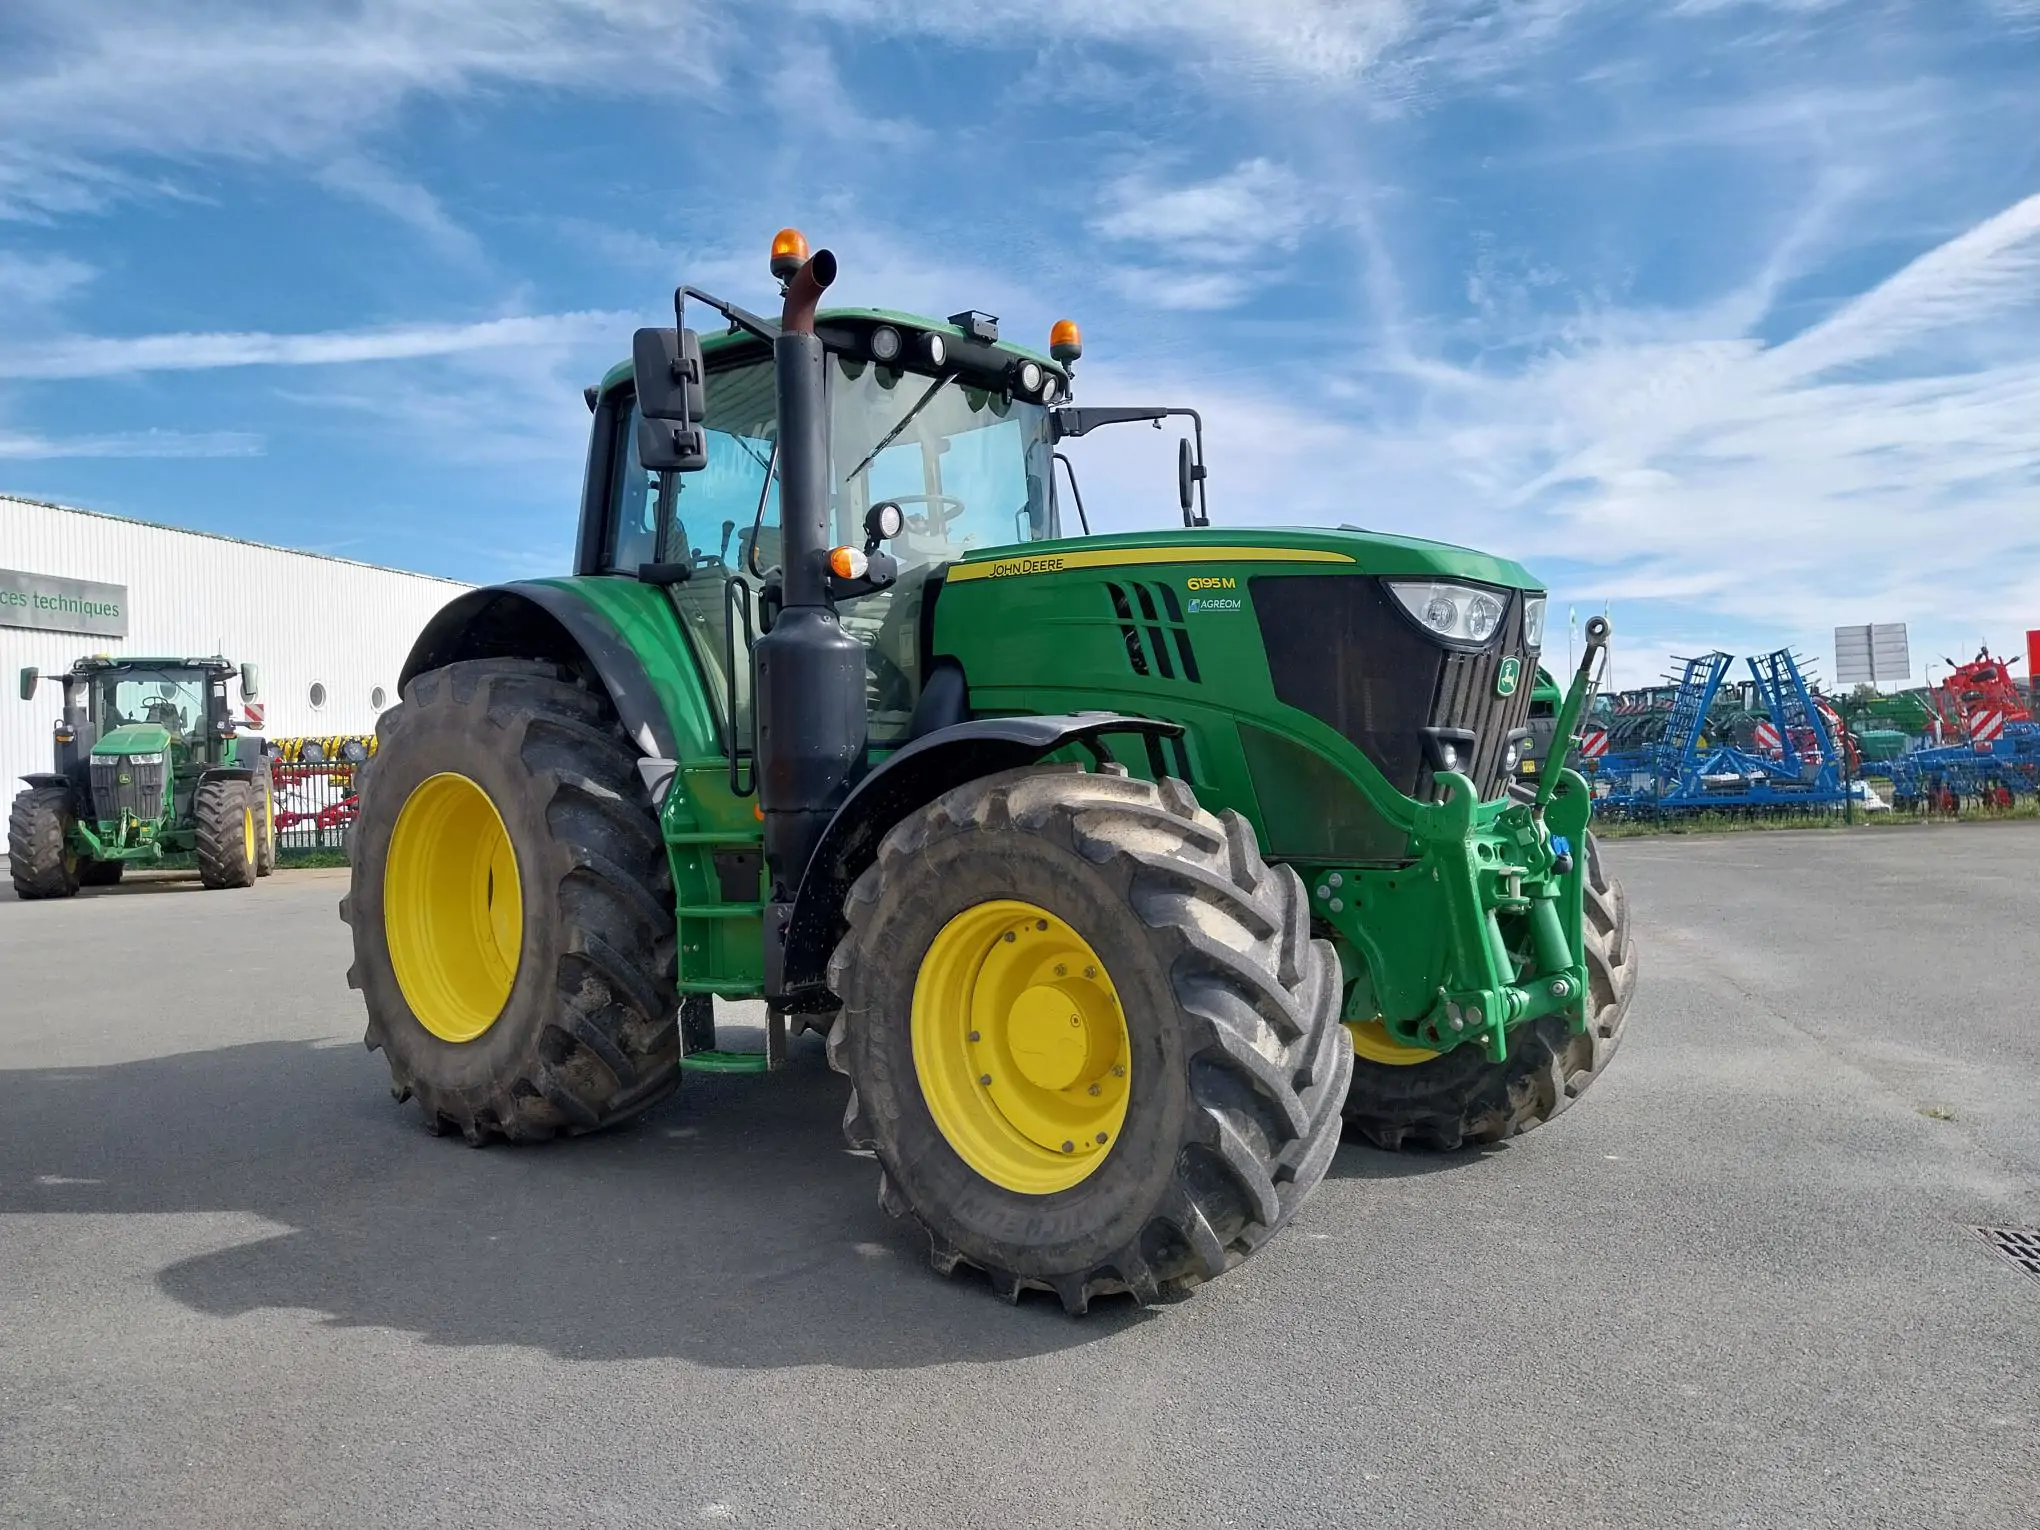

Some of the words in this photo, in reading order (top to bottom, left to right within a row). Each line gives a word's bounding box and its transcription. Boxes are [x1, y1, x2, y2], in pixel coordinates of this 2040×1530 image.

[989, 563, 1021, 576] JOHN
[1022, 558, 1064, 573] DEERE
[33, 590, 120, 618] techniques
